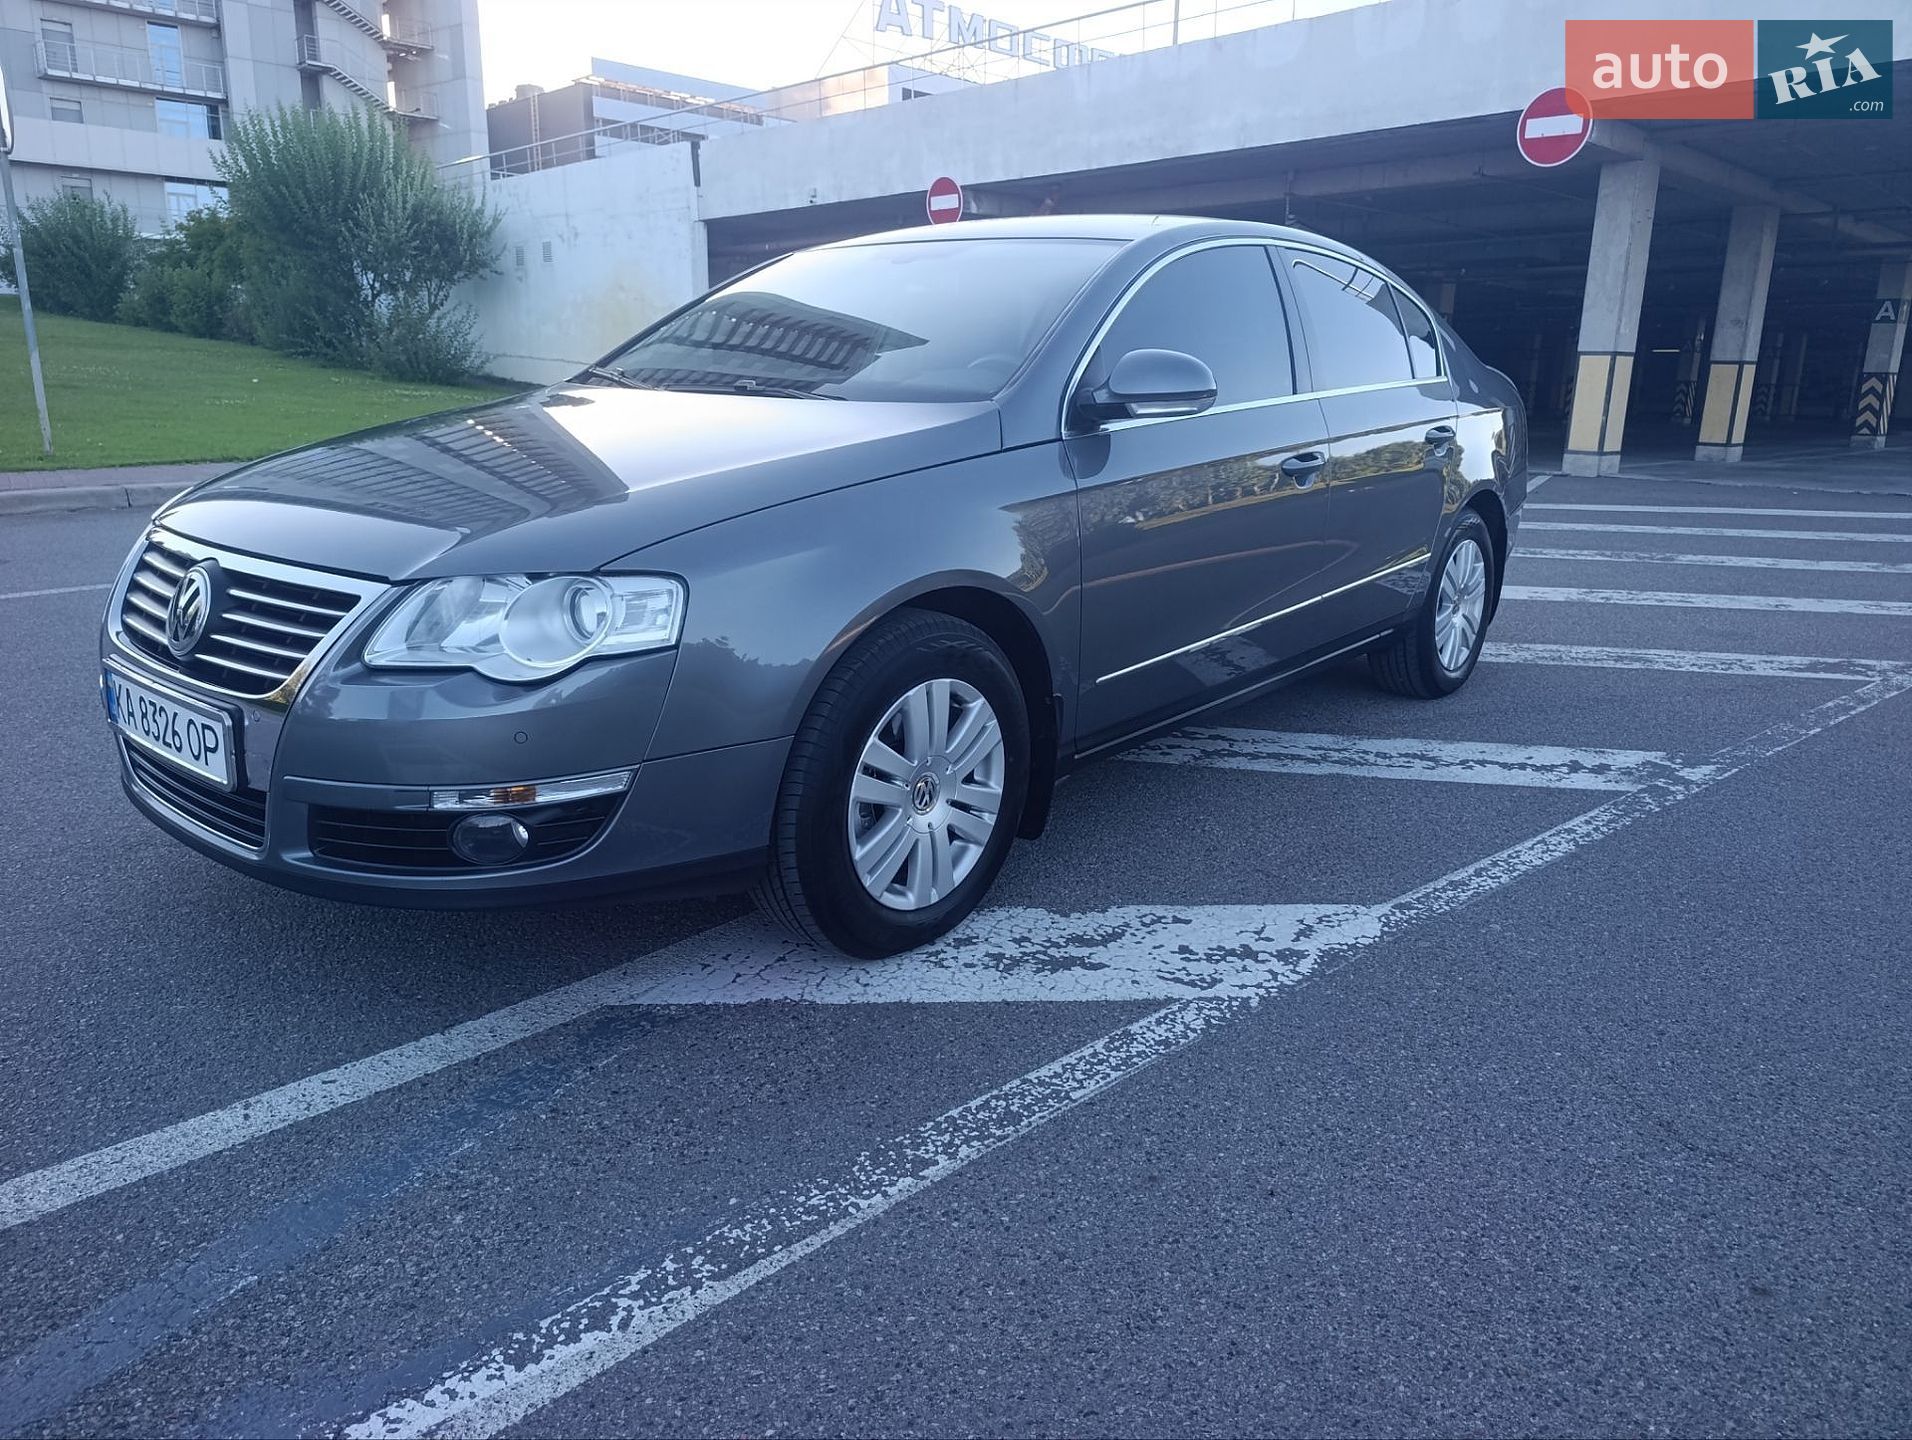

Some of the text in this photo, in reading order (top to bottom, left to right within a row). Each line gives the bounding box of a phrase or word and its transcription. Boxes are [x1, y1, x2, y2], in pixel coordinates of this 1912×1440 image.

[113, 680, 219, 767] KA 8326 OP
